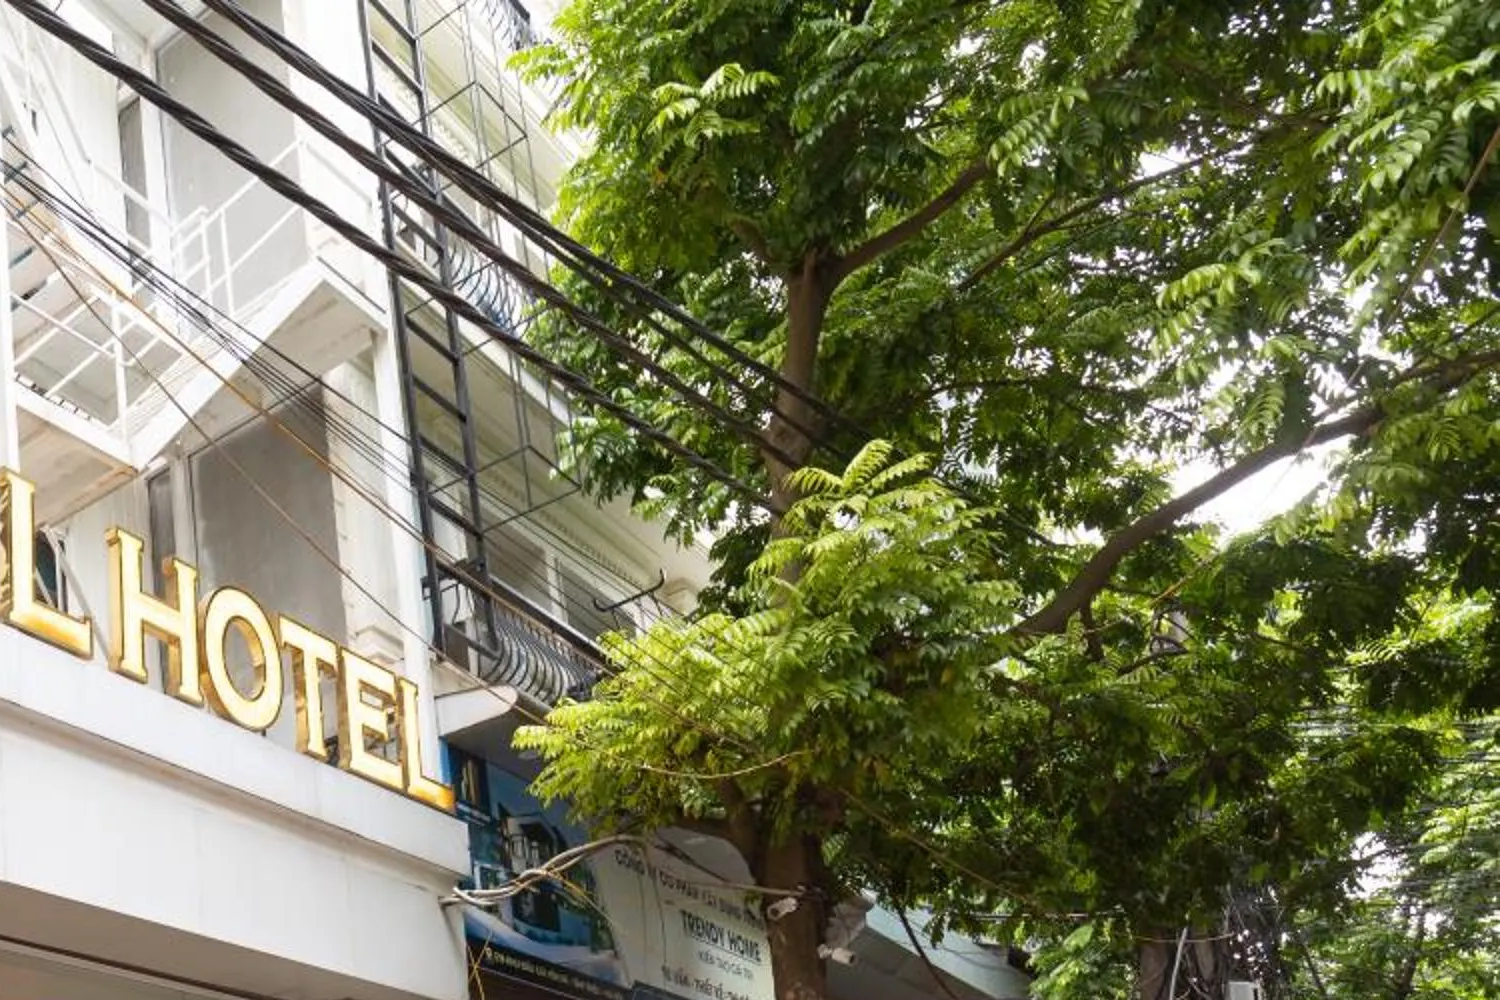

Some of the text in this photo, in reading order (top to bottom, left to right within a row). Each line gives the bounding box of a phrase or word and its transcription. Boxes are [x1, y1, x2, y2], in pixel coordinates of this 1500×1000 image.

[106, 524, 455, 813] HOTEL
[680, 909, 724, 947] TRENDY
[726, 929, 761, 962] HOME
